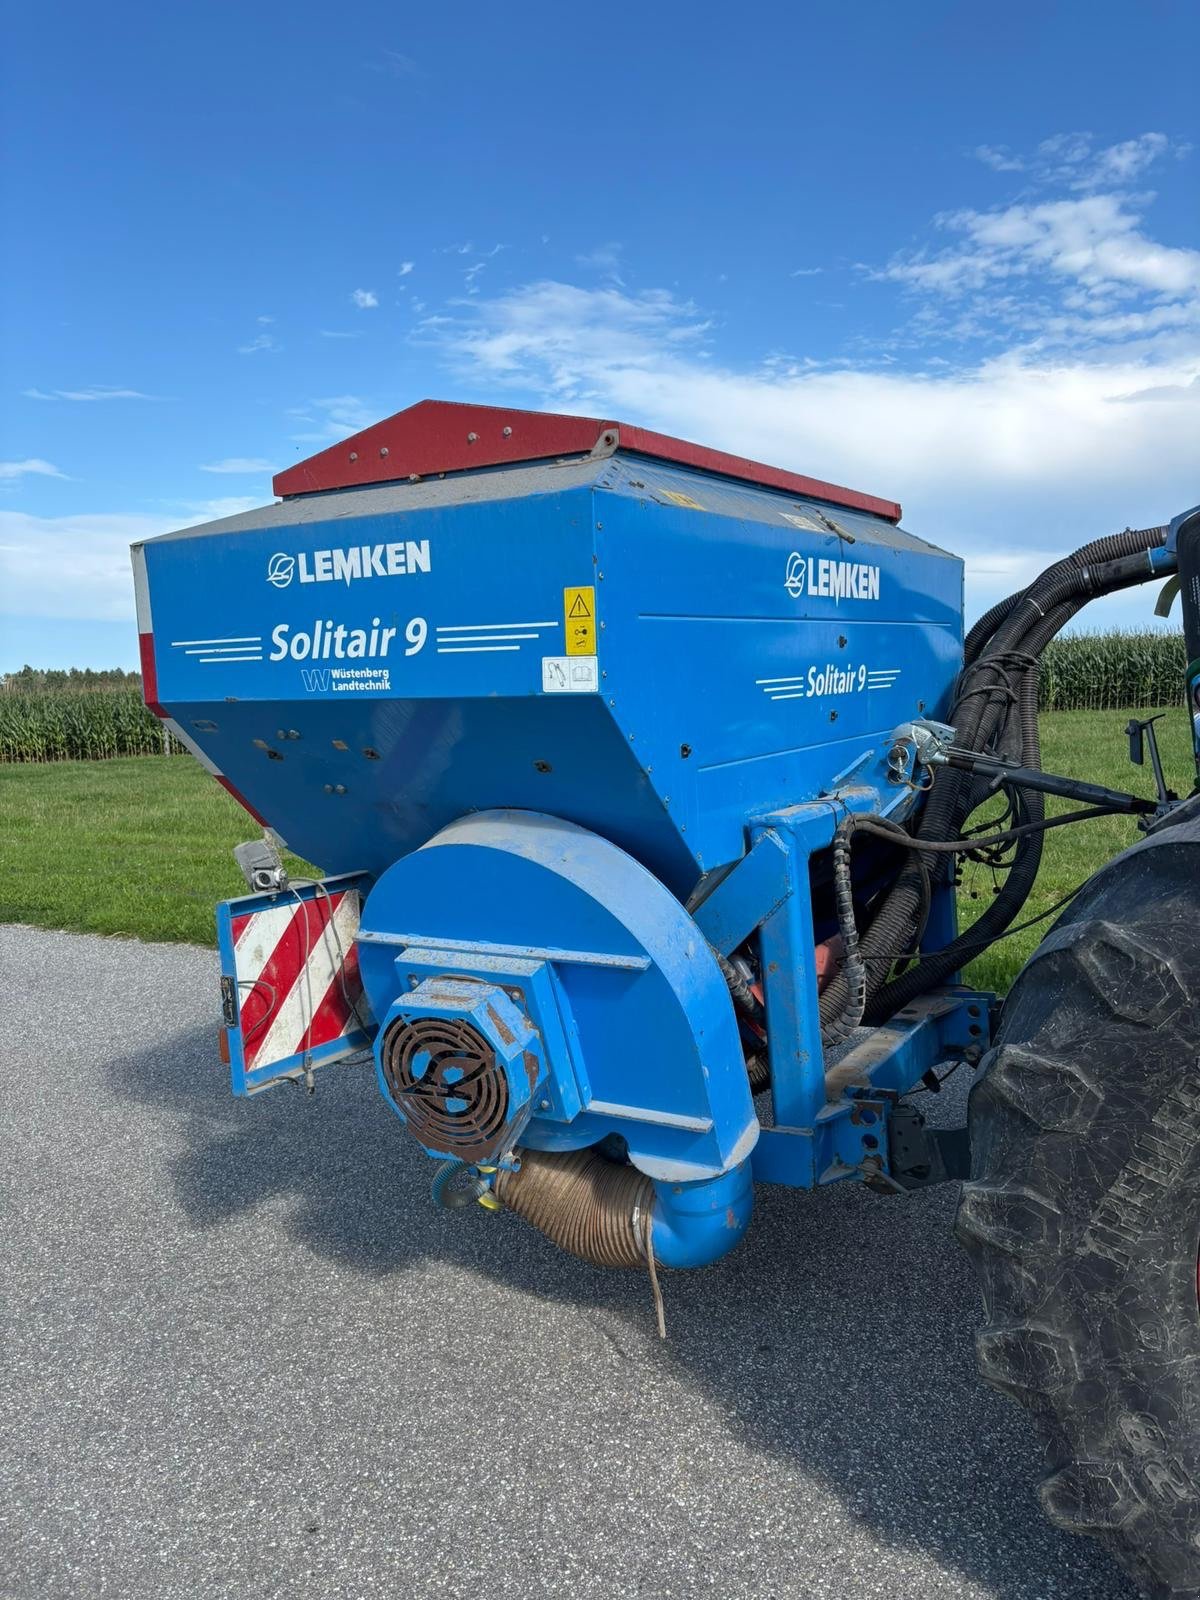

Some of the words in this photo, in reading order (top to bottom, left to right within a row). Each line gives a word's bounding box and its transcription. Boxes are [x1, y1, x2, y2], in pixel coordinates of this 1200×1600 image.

[298, 540, 432, 588] LEMKEN
[807, 557, 880, 607] LEMKEN
[269, 617, 397, 661] Solitair
[405, 617, 428, 656] 9
[331, 667, 390, 680] Wüstenberg
[332, 679, 391, 692] Landtechnik
[806, 664, 856, 698] Solitair
[858, 664, 867, 692] 9
